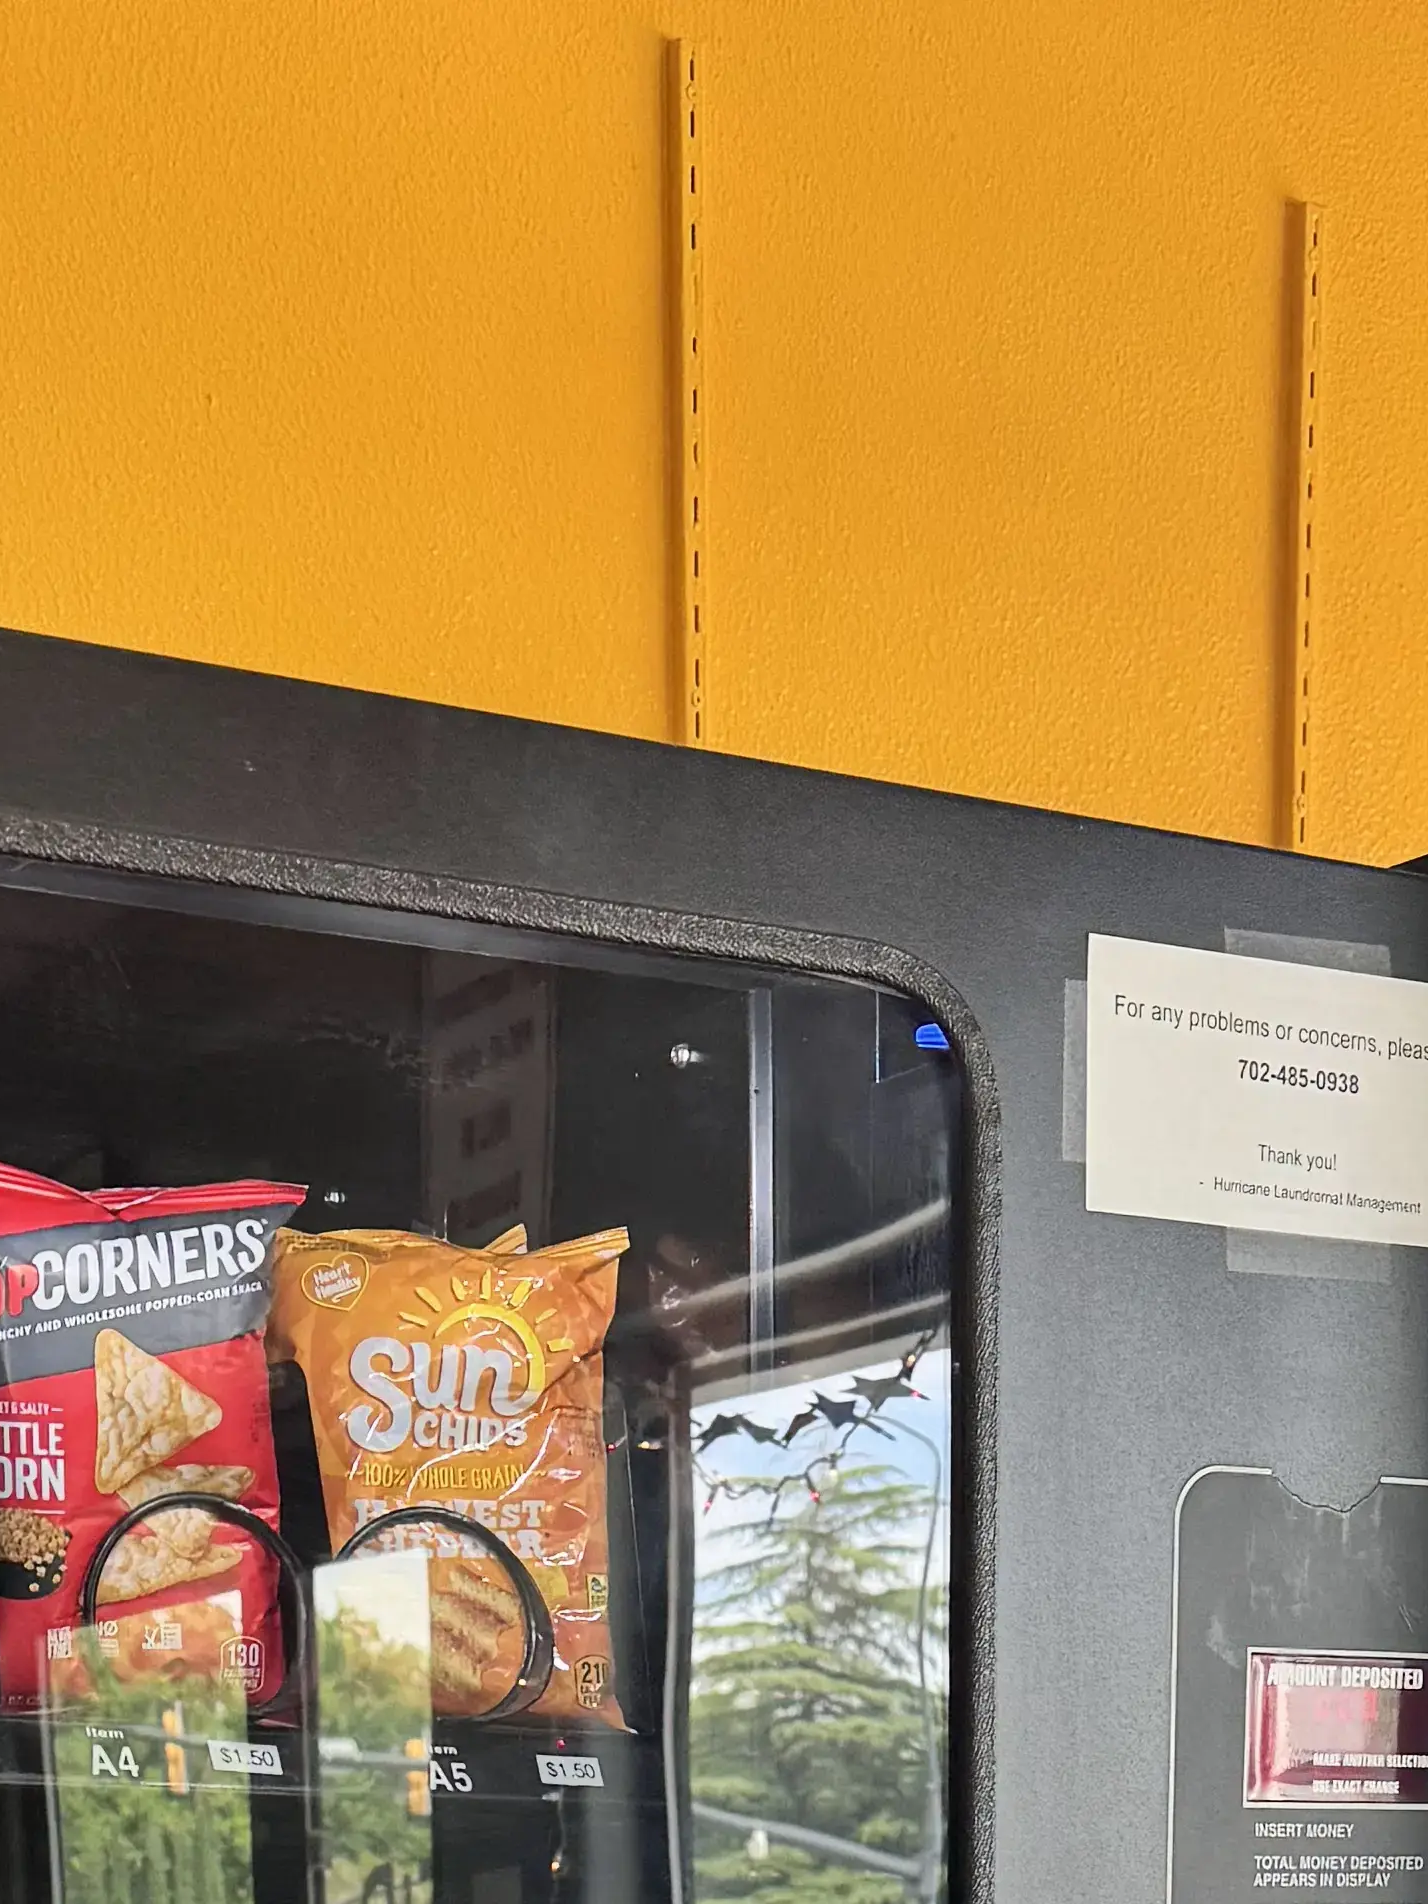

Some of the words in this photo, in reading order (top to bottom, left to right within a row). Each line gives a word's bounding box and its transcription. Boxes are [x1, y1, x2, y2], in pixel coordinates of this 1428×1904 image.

[1114, 994, 1146, 1020] For
[1151, 1004, 1184, 1030] any
[1188, 1006, 1270, 1038] problems
[1275, 1022, 1294, 1042] or
[1298, 1027, 1383, 1057] concerns,
[1238, 1058, 1360, 1095] 702-485-0938
[1258, 1143, 1302, 1167] Thank
[1306, 1153, 1337, 1172] you!
[1213, 1176, 1271, 1199] Hurricane
[1274, 1184, 1344, 1207] Laundromat
[1346, 1192, 1422, 1215] Management
[346, 1336, 546, 1453] Sun
[413, 1413, 528, 1451] CHIPS
[364, 1463, 407, 1488] 100%
[410, 1463, 467, 1489] WHOLE
[471, 1463, 524, 1491] GRAIN
[227, 1643, 260, 1666] 130
[1267, 1662, 1339, 1688] AMOUNT
[1341, 1665, 1424, 1691] DEPOSITED
[91, 1744, 140, 1778] A4
[220, 1747, 275, 1768] $1.50
[544, 1761, 597, 1783] $1.50
[1254, 1822, 1303, 1838] INSERT
[1306, 1823, 1355, 1839] MONEY
[1254, 1855, 1297, 1870] TOTAL
[1299, 1855, 1348, 1871] MONEY
[1350, 1855, 1424, 1871] DEPOSITED
[1252, 1872, 1317, 1888] APPEARS
[1319, 1872, 1334, 1887] IN
[1335, 1872, 1392, 1888] DISPLAY
